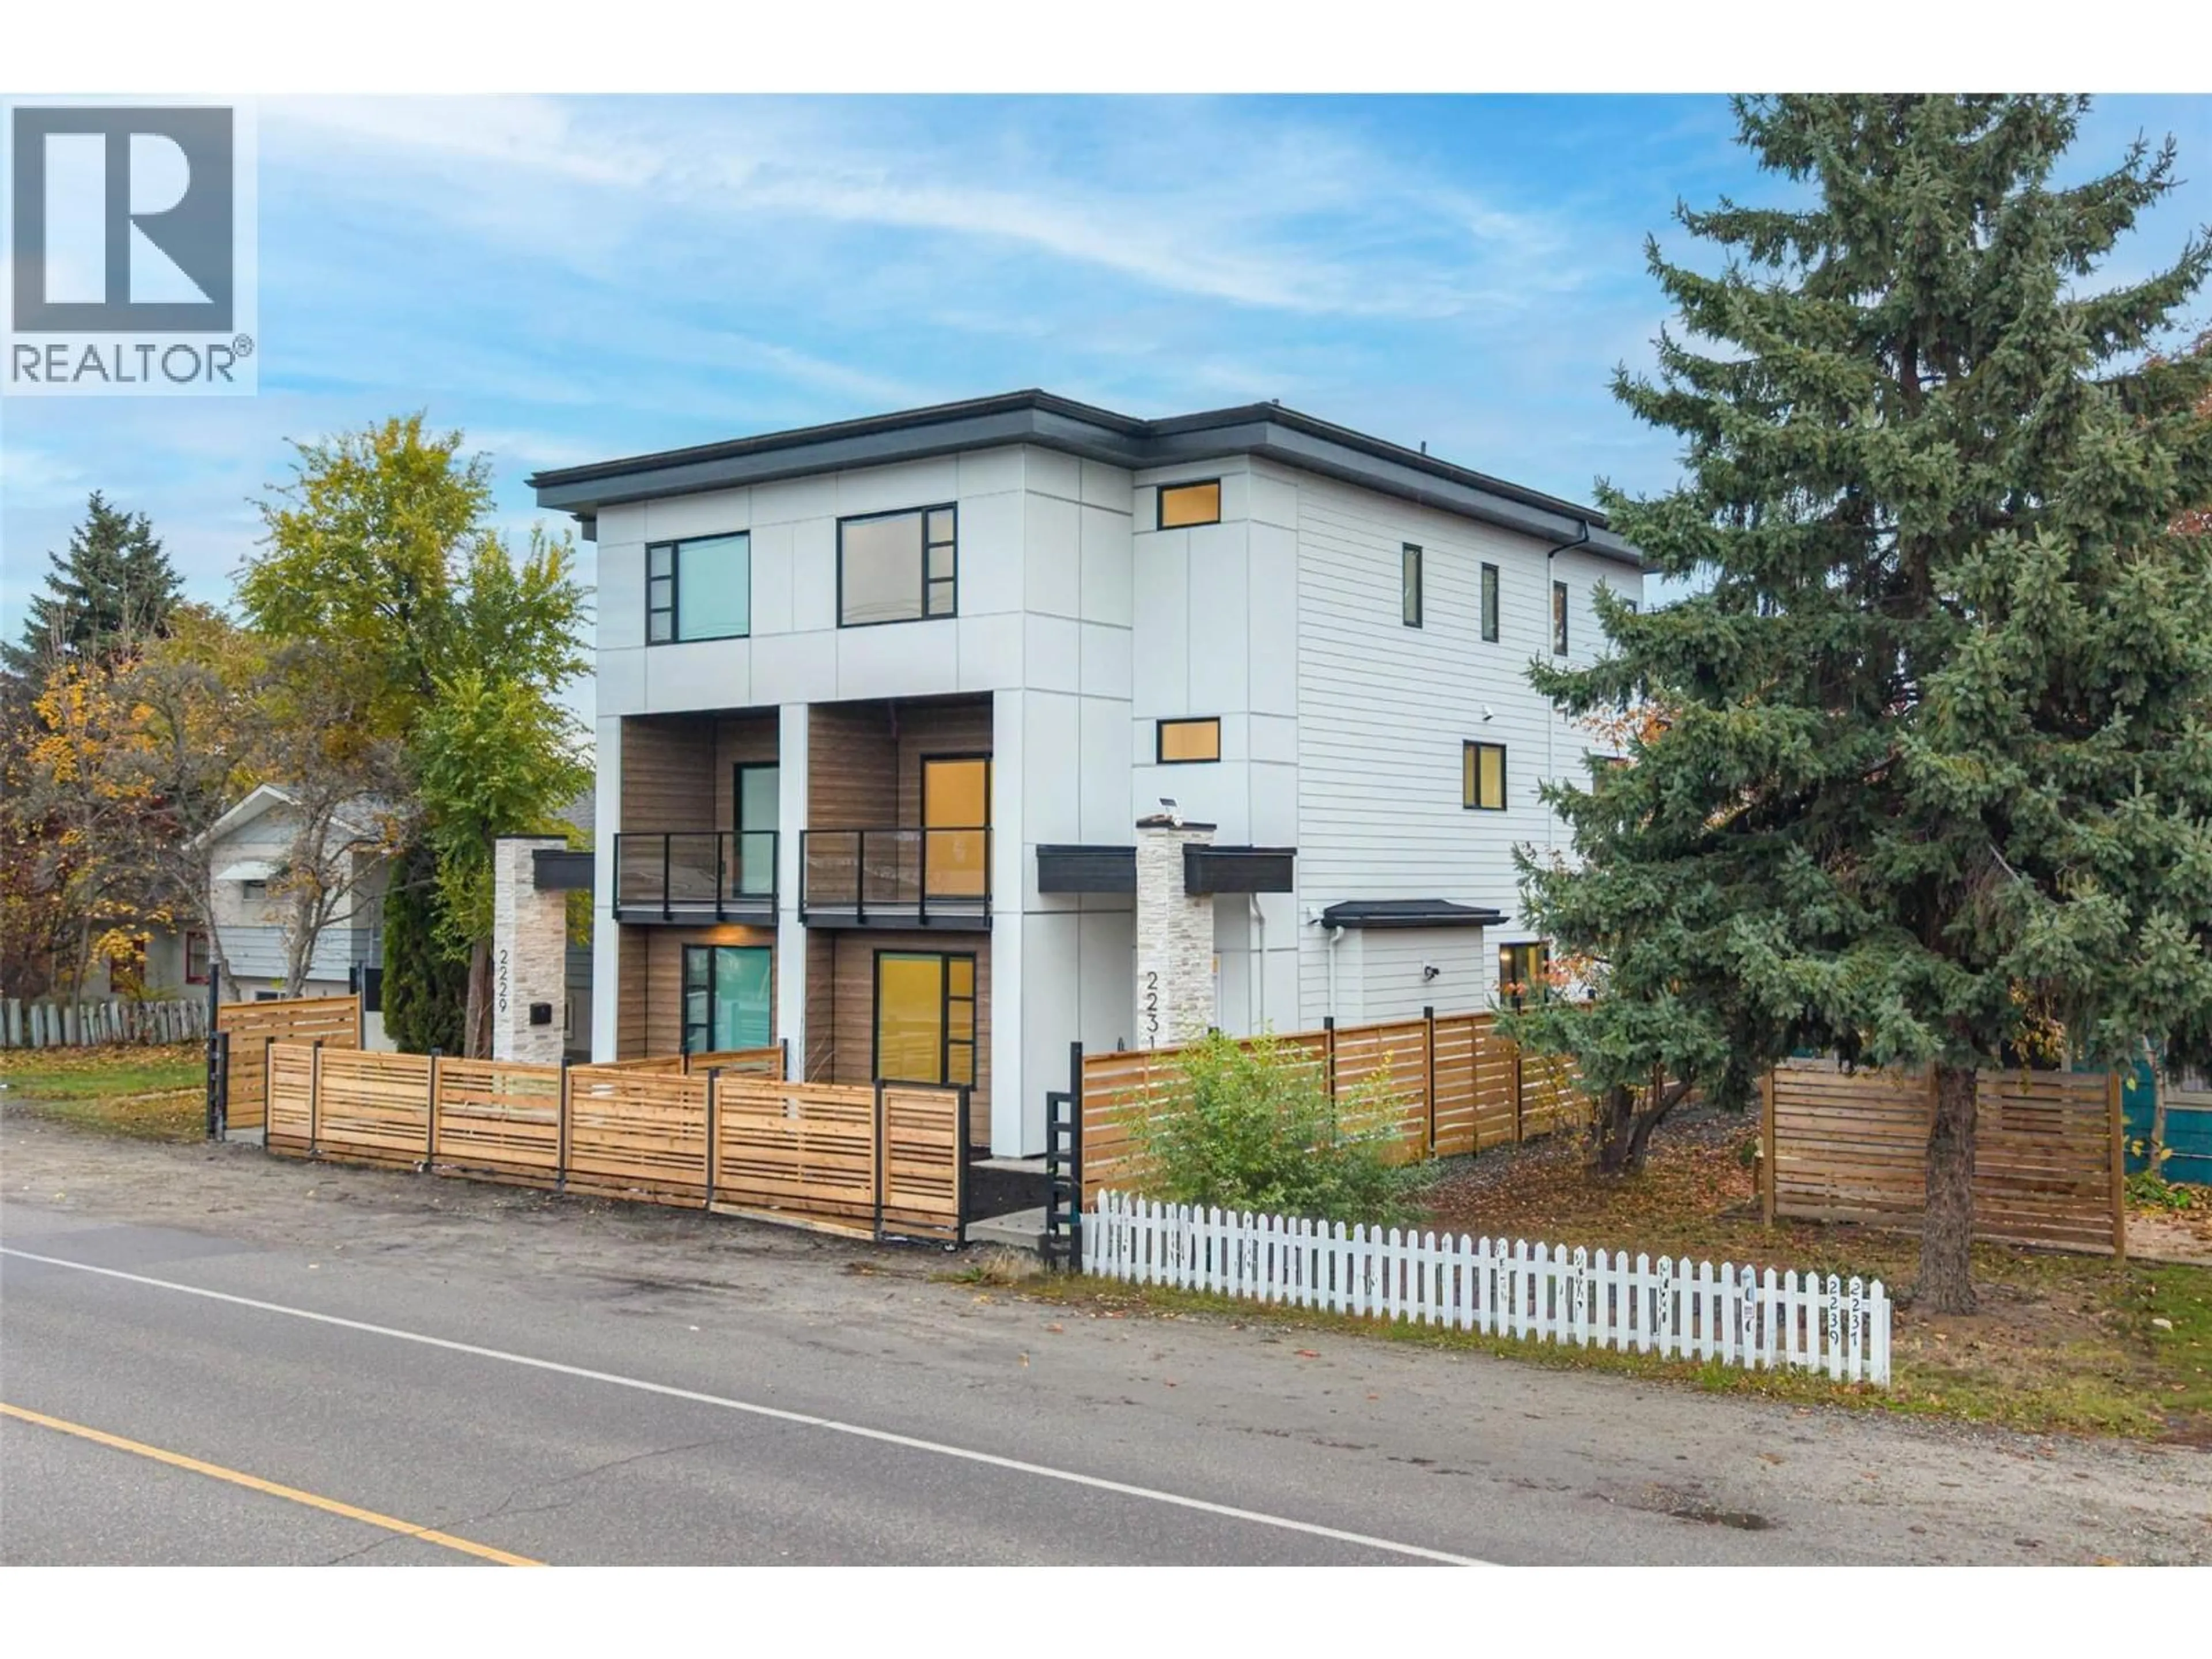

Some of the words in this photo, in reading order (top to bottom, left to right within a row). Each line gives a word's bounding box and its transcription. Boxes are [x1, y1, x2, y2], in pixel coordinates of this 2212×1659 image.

[499, 949, 508, 1013] 2229
[1146, 971, 1159, 1049] 2231
[1829, 1281, 1839, 1345] 2239
